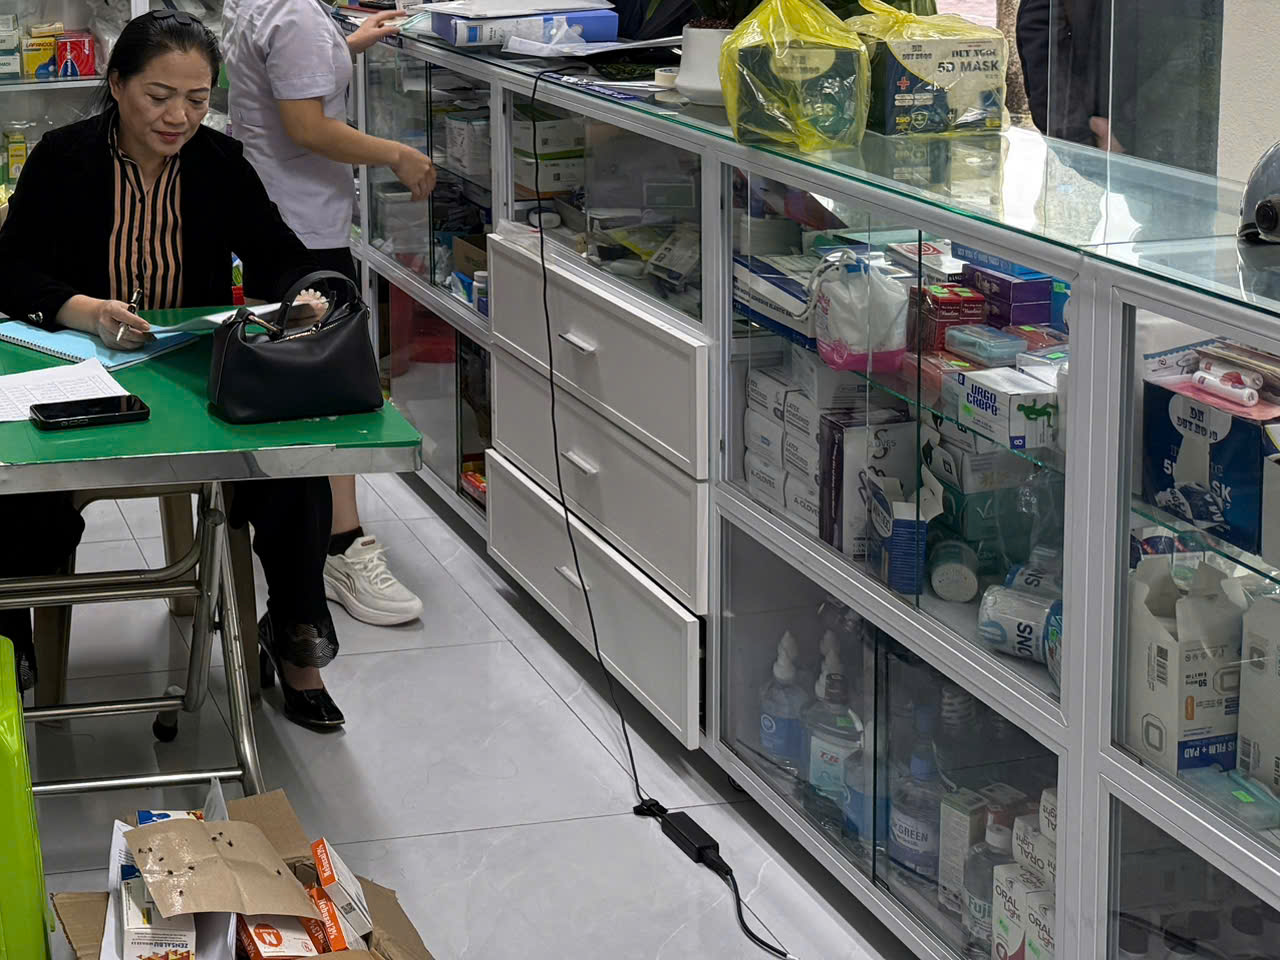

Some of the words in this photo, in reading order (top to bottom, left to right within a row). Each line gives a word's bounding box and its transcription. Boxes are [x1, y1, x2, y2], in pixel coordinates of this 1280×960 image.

[960, 58, 1000, 73] MASK
[971, 383, 997, 405] URGO
[1184, 747, 1200, 758] PAD
[1209, 742, 1227, 755] FILM
[995, 884, 1020, 912] ORAL
[1028, 913, 1054, 940] ORAL
